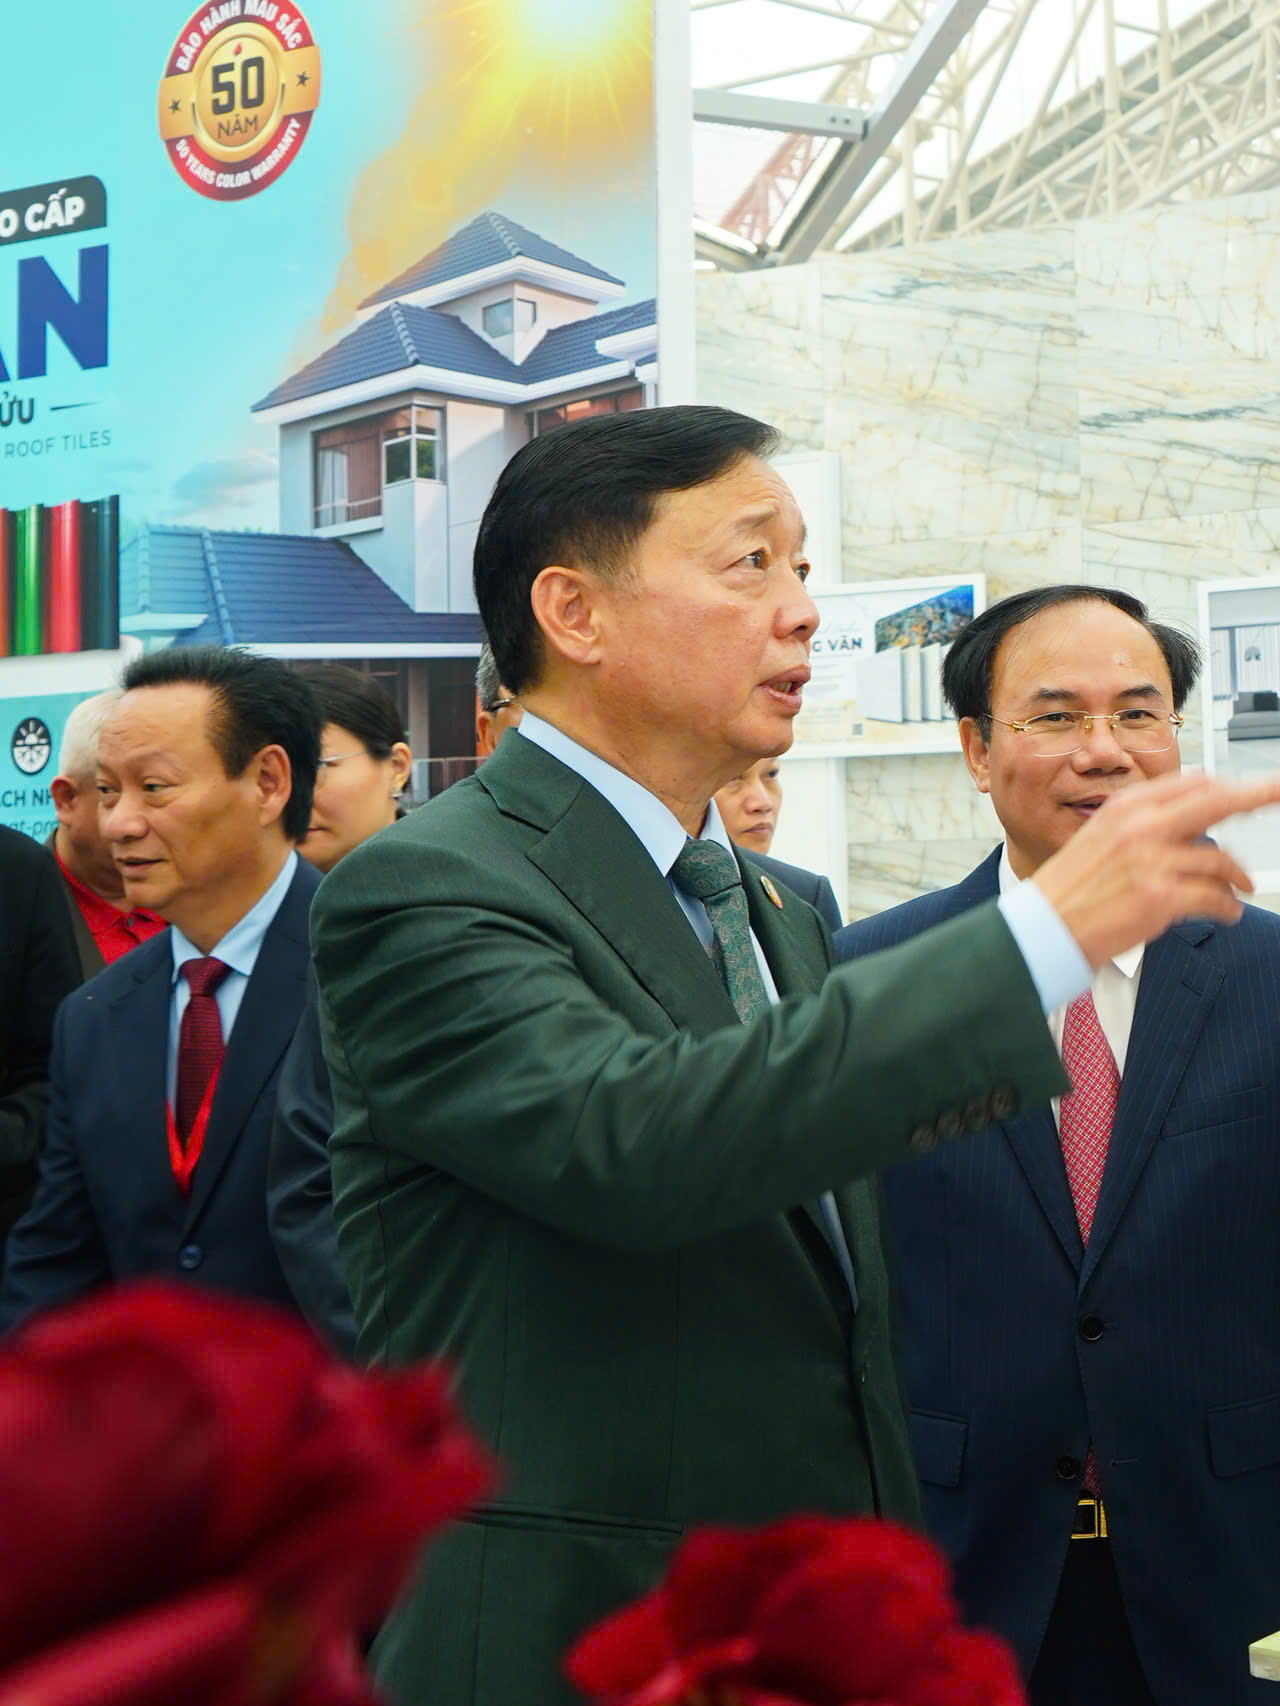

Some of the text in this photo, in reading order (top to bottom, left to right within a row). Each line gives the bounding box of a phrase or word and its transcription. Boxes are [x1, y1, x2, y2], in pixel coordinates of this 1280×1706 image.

[211, 56, 265, 115] 50
[217, 114, 259, 138] NĂM
[185, 154, 217, 184] YEARS
[216, 170, 251, 188] COLOR
[250, 118, 301, 181] WARRANTY
[0, 187, 86, 237] O CẤP
[0, 391, 35, 427] ỬU
[4, 429, 112, 459] ROOF TILES
